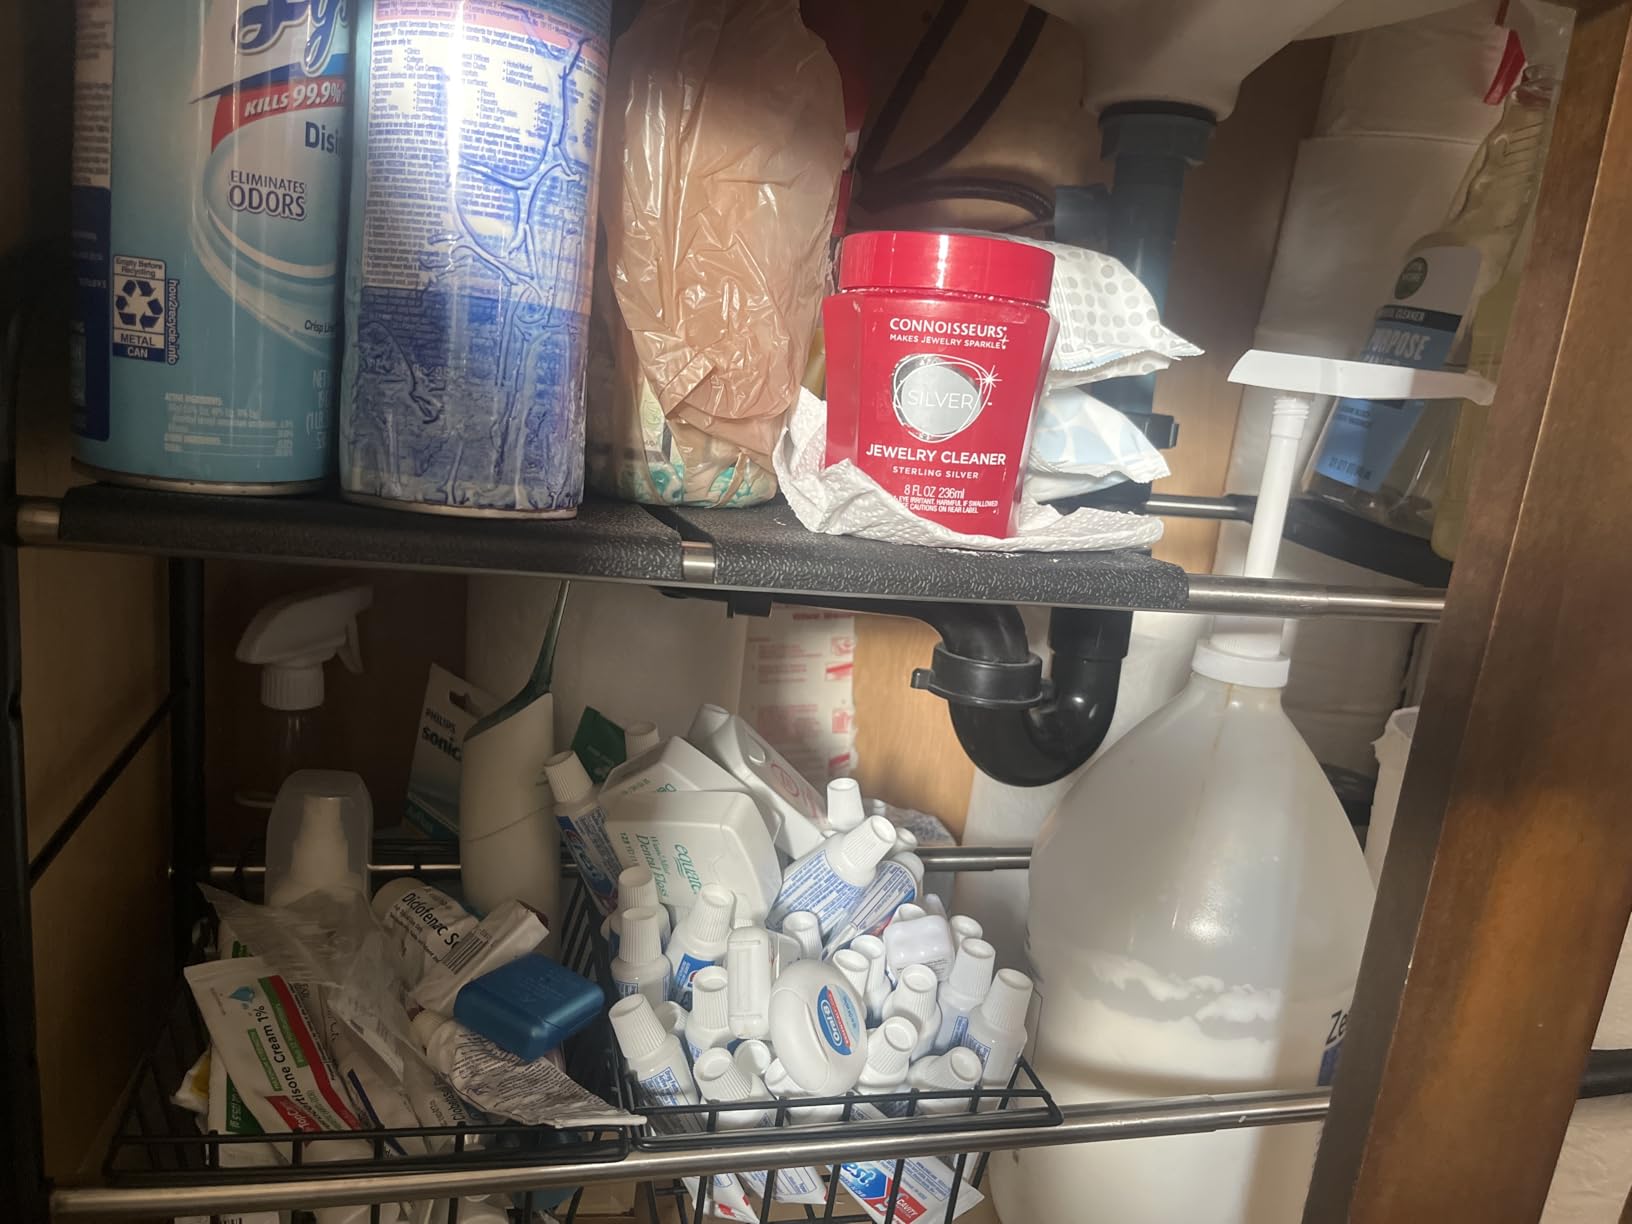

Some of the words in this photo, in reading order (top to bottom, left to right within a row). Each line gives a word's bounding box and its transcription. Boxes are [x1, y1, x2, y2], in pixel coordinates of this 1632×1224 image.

[244, 91, 289, 118] KILLS
[292, 80, 342, 108] 99.9%
[230, 170, 306, 194] ELIMINATES
[229, 184, 306, 219] ODORS
[116, 258, 136, 270] Empty
[138, 260, 163, 271] Before
[121, 266, 156, 278] Recycling
[168, 279, 178, 364] how2recycle.info
[304, 320, 323, 333] Crisp
[890, 318, 1004, 338] CONNOISSEURS
[120, 333, 156, 347] METAL
[890, 334, 919, 343] MAKES
[921, 336, 962, 346] JEWELRY
[127, 346, 148, 358] CAN
[906, 390, 974, 410] SILVER
[866, 444, 937, 462] JEWELRY
[940, 450, 1006, 466] CLEANER
[892, 466, 942, 478] STERLING
[945, 470, 979, 480] SILVER
[904, 484, 910, 495] 8
[912, 485, 922, 496] FL
[924, 486, 936, 498] OZ
[938, 488, 965, 499] 236ml
[910, 504, 938, 512] CAUTIONS
[962, 506, 978, 514] LABEL
[636, 833, 658, 877] Dental
[652, 870, 670, 898] Floss
[675, 844, 703, 893] equate
[401, 892, 448, 936] Diclofenac
[254, 1005, 266, 1024] 1%
[264, 1023, 286, 1064] Cream
[286, 1107, 310, 1130] TopC
[896, 1198, 918, 1217] CAVITY
